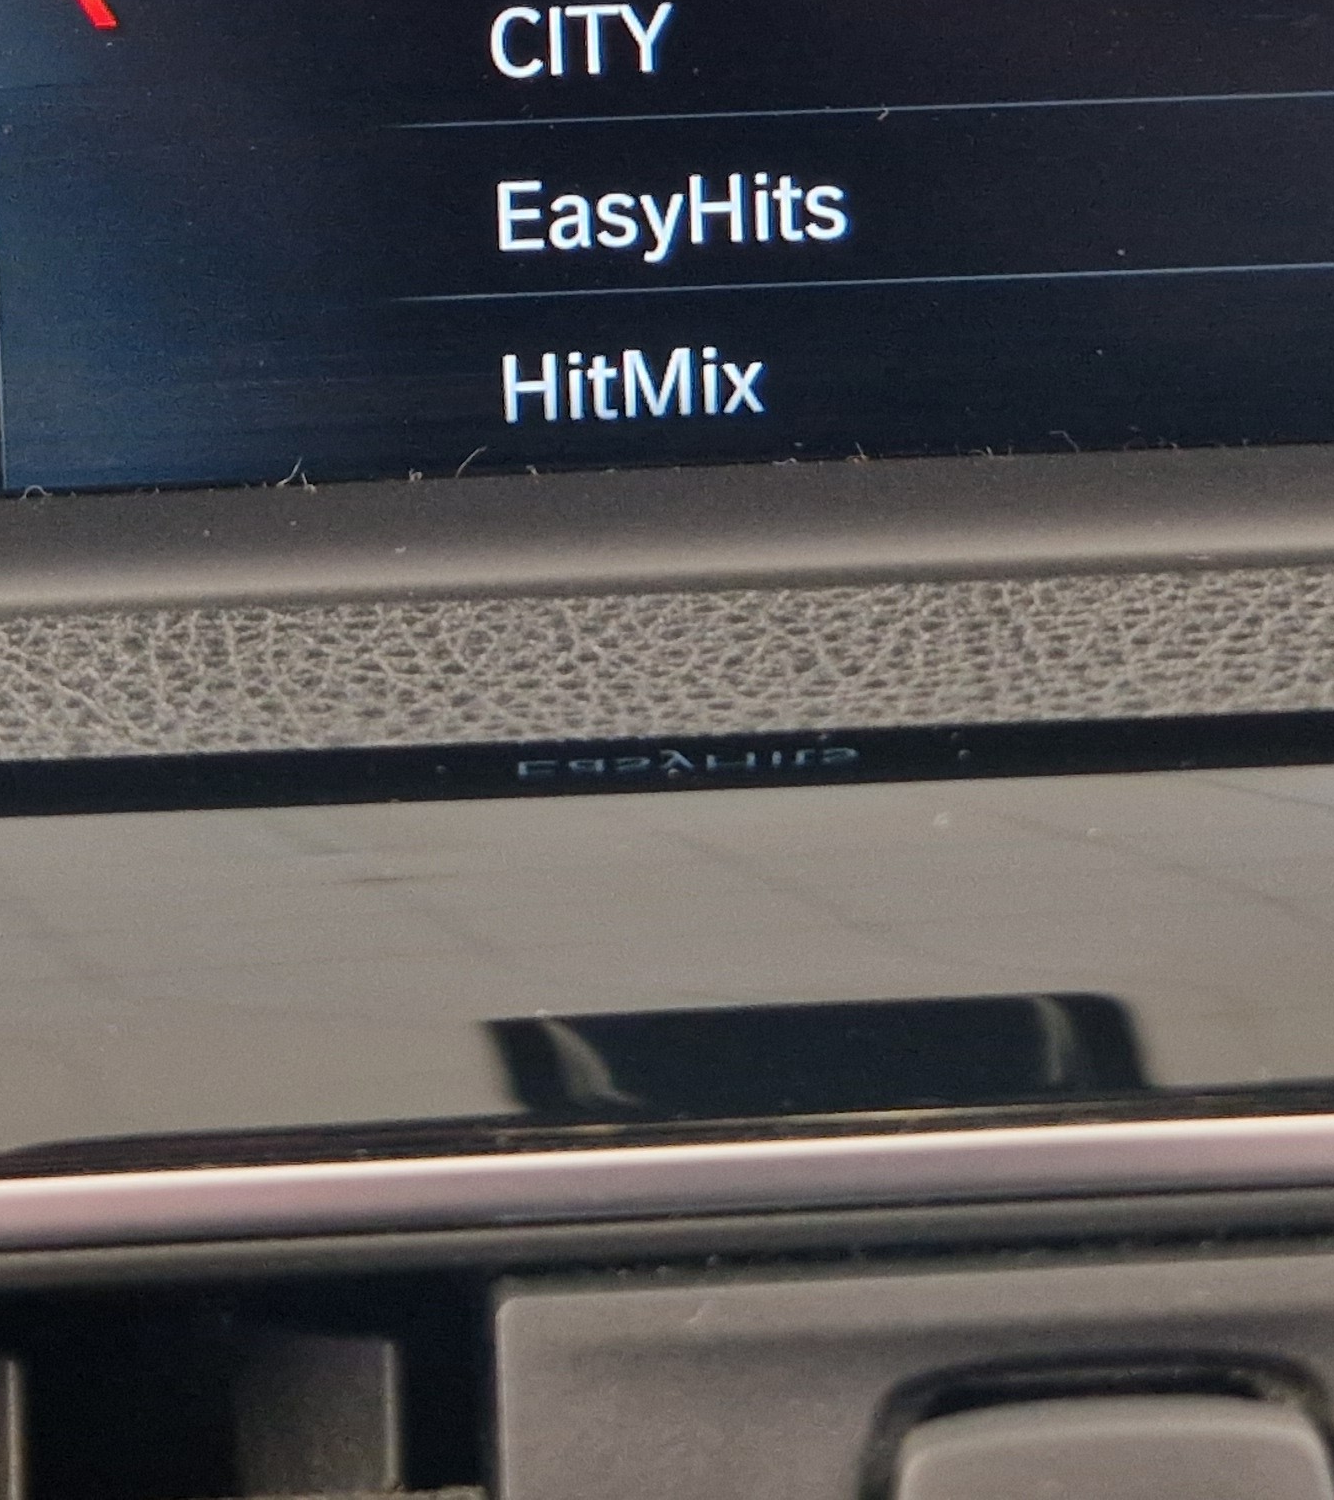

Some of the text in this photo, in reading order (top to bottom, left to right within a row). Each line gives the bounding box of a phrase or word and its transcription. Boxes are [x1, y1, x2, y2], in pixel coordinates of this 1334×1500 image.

[490, 1, 673, 79] CITY
[497, 171, 848, 263] EasyHits
[502, 346, 764, 423] HitMix
